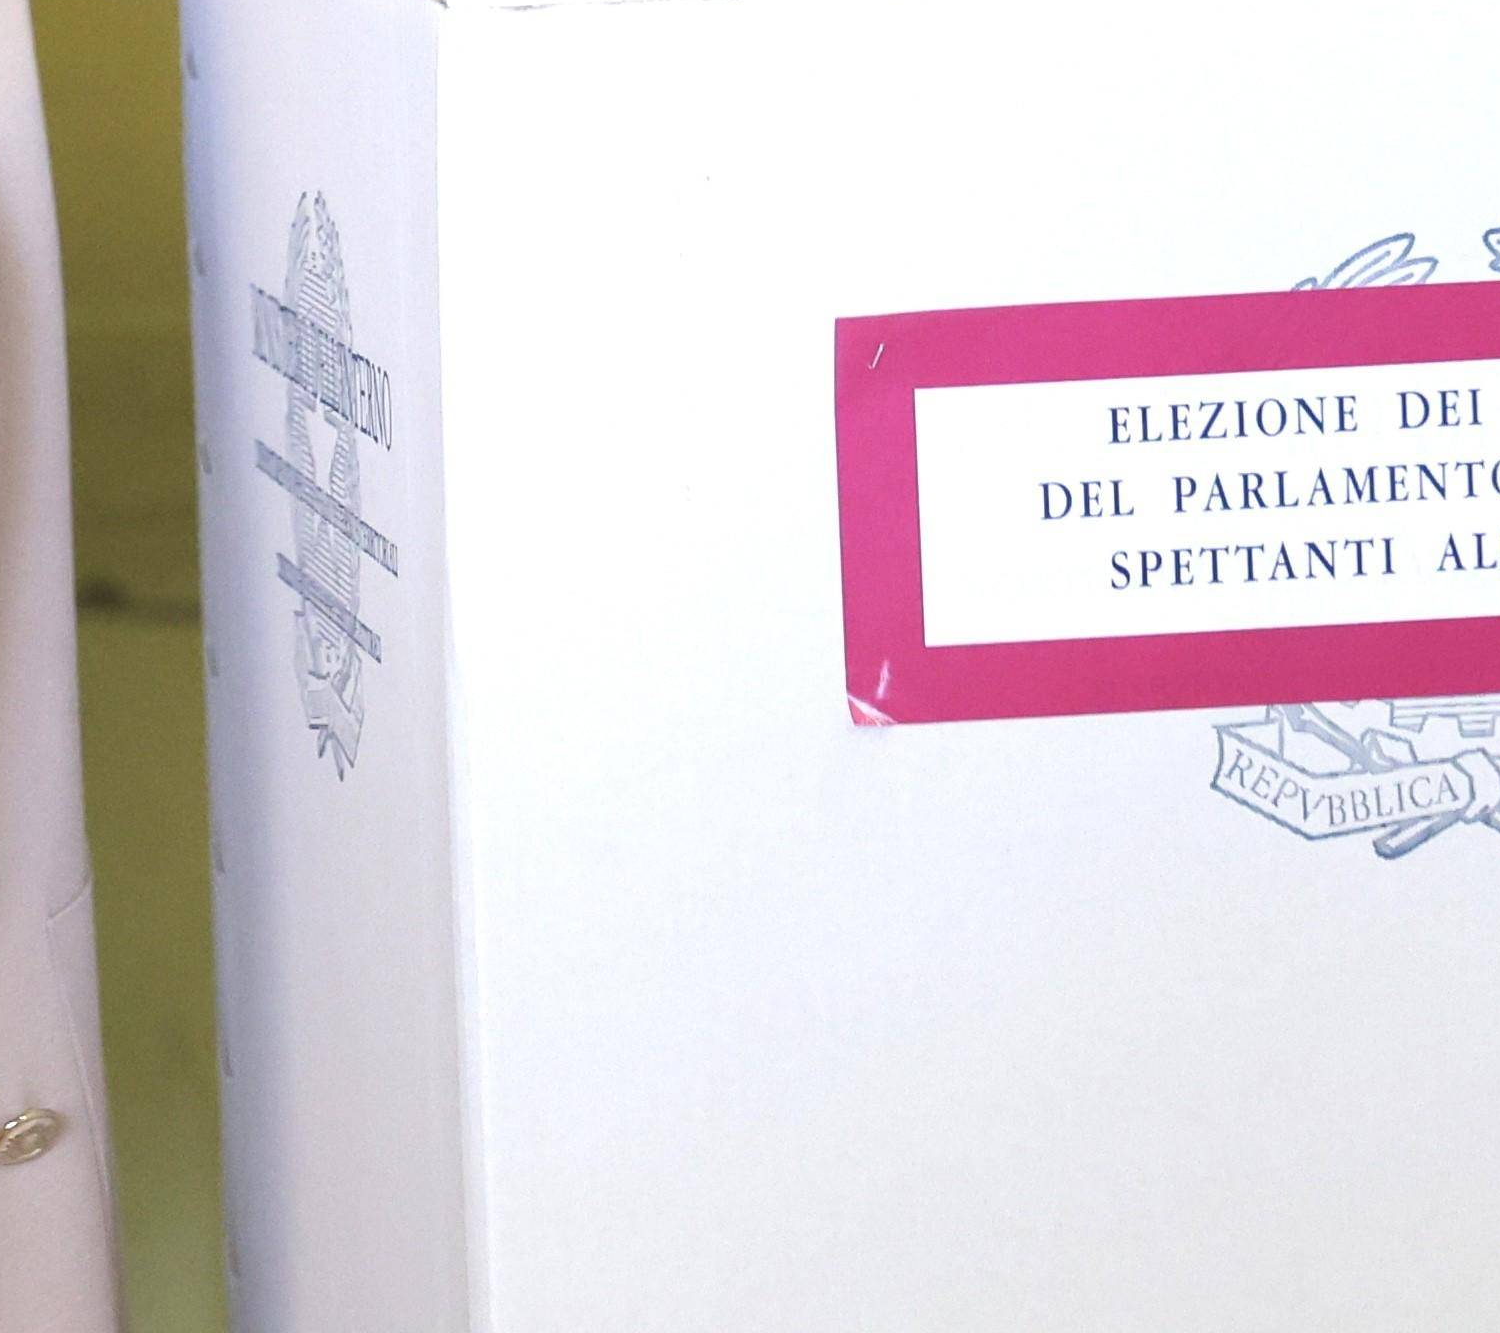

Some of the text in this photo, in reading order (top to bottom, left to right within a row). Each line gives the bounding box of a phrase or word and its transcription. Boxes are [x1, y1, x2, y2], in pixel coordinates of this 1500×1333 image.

[1108, 393, 1360, 447] ELEZIONE
[1399, 384, 1483, 431] DEI
[1040, 478, 1138, 522] DEL
[1109, 538, 1398, 591] SPETTANTI
